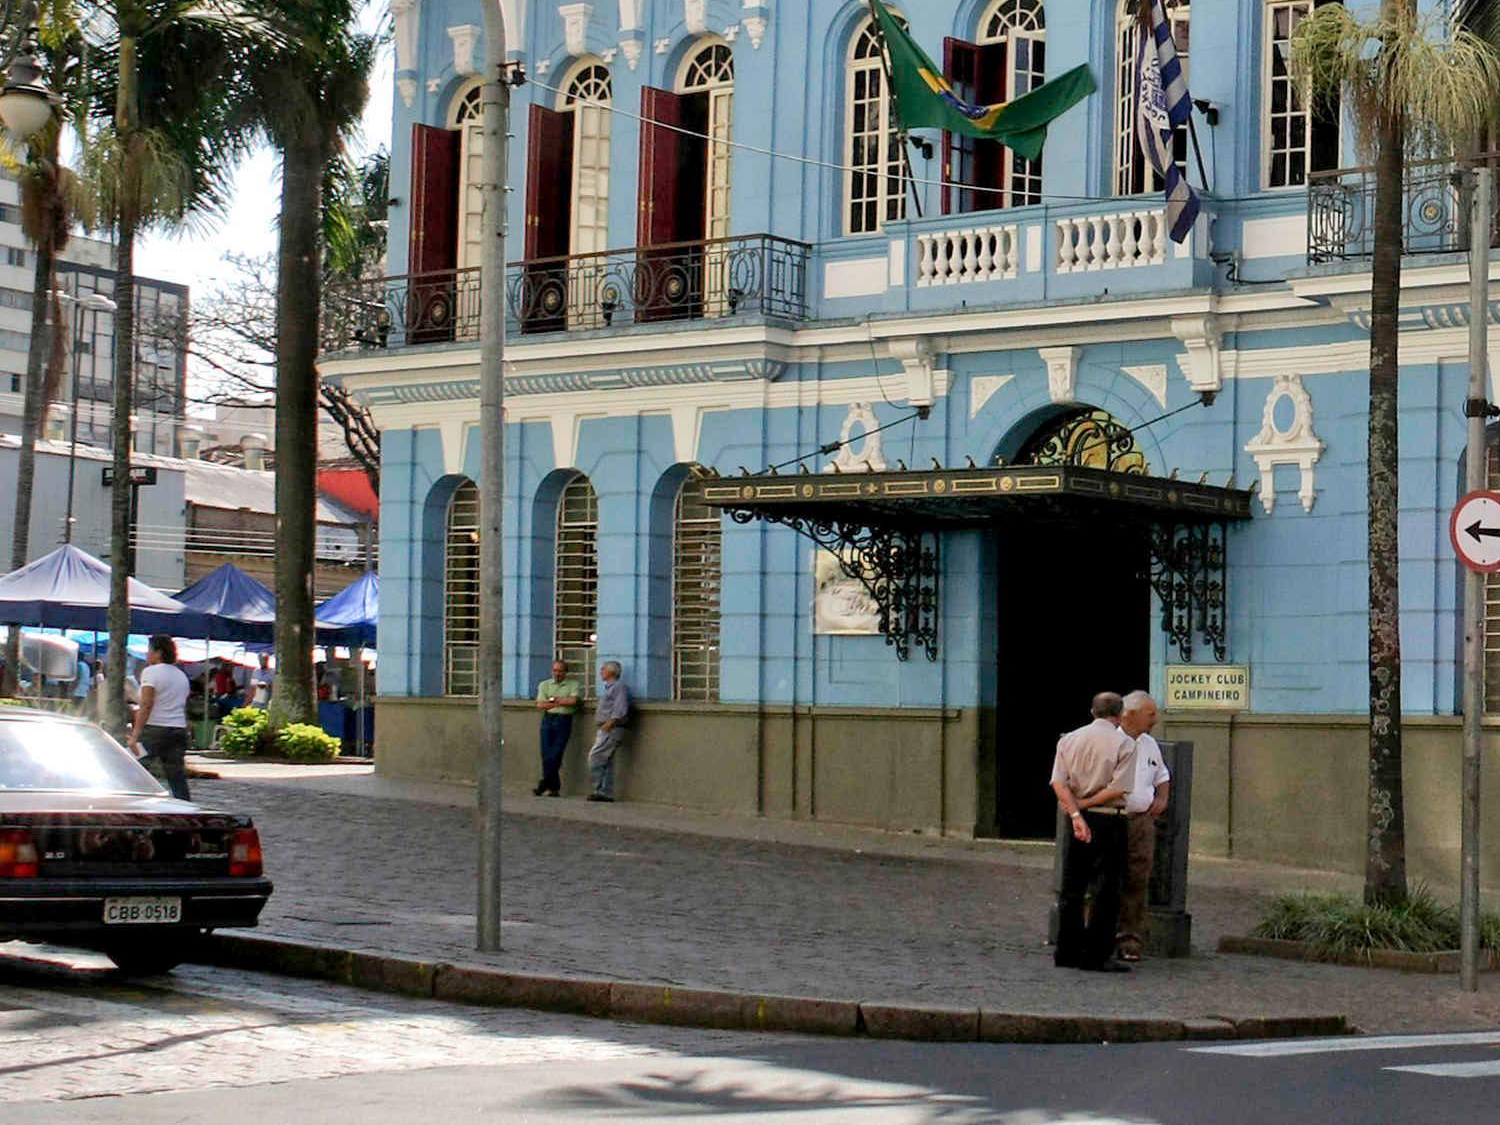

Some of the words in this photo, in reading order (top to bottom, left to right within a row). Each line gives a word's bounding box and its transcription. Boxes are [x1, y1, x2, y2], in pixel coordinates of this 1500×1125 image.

[1170, 674, 1211, 684] JOCKEY
[1217, 674, 1245, 684] CLUB
[1174, 690, 1240, 700] CAMPINEIRO
